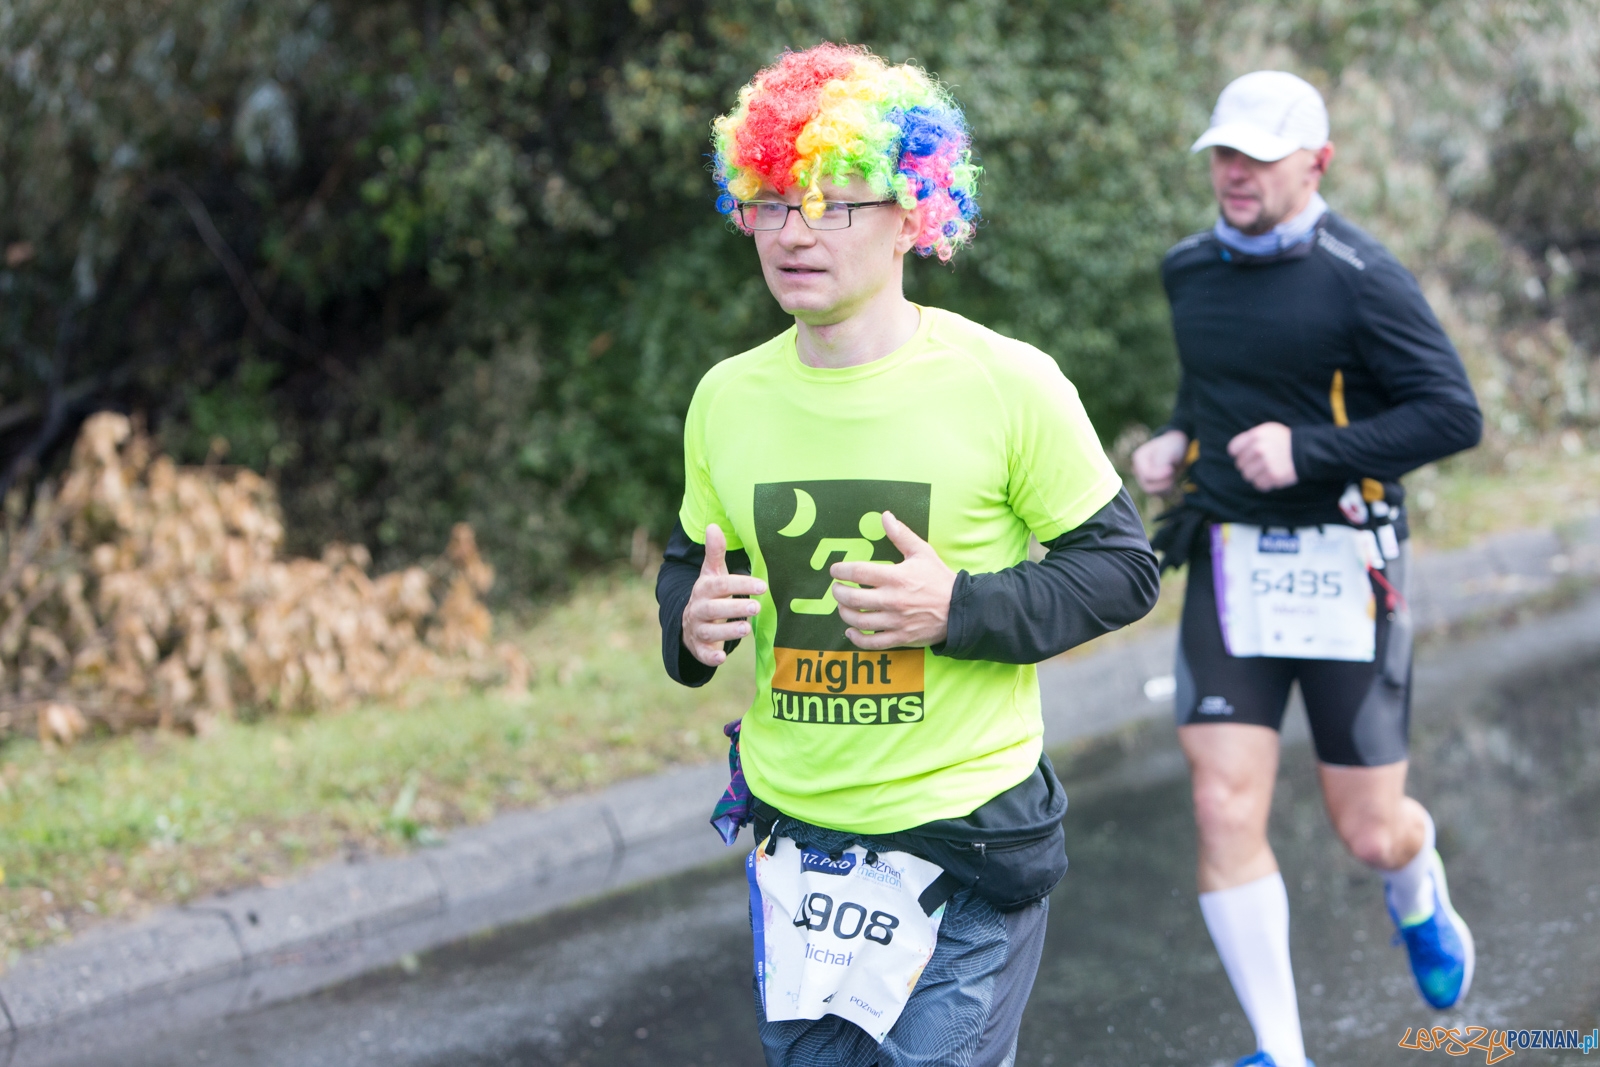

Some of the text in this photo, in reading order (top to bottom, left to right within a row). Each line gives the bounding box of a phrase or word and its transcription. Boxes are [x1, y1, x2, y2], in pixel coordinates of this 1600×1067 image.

[1251, 569, 1342, 598] 5435
[795, 651, 892, 693] night
[773, 691, 923, 724] runners
[802, 853, 819, 865] 17.
[857, 866, 902, 888] maraton
[793, 892, 900, 946] 4908
